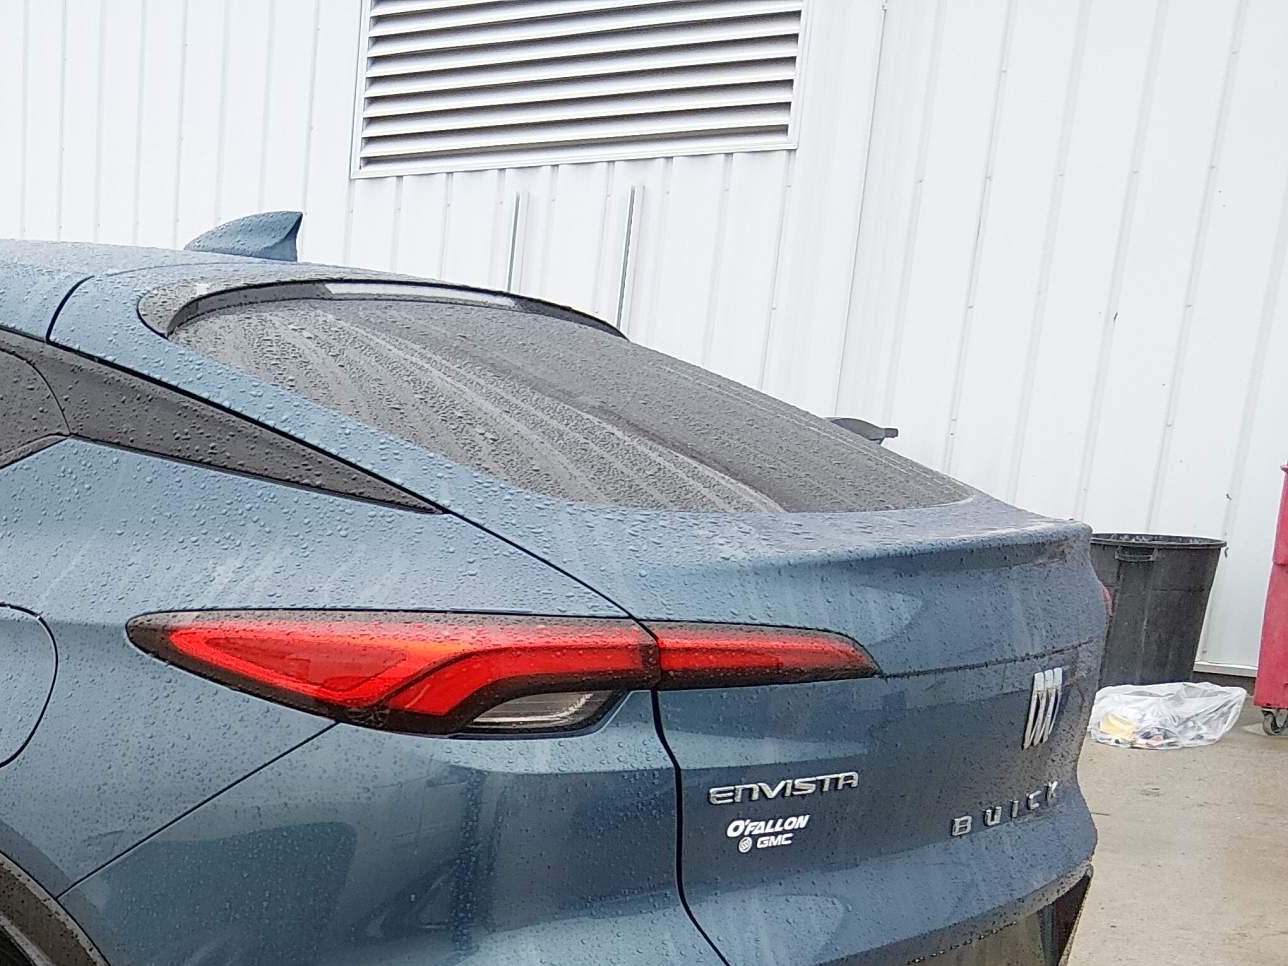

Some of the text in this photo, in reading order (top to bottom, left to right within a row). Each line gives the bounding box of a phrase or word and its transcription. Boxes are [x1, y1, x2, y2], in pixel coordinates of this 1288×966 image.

[708, 771, 859, 805] ENVISTA
[951, 780, 1059, 837] BUICK
[726, 813, 811, 839] O'FALLON
[756, 832, 793, 850] GMC
